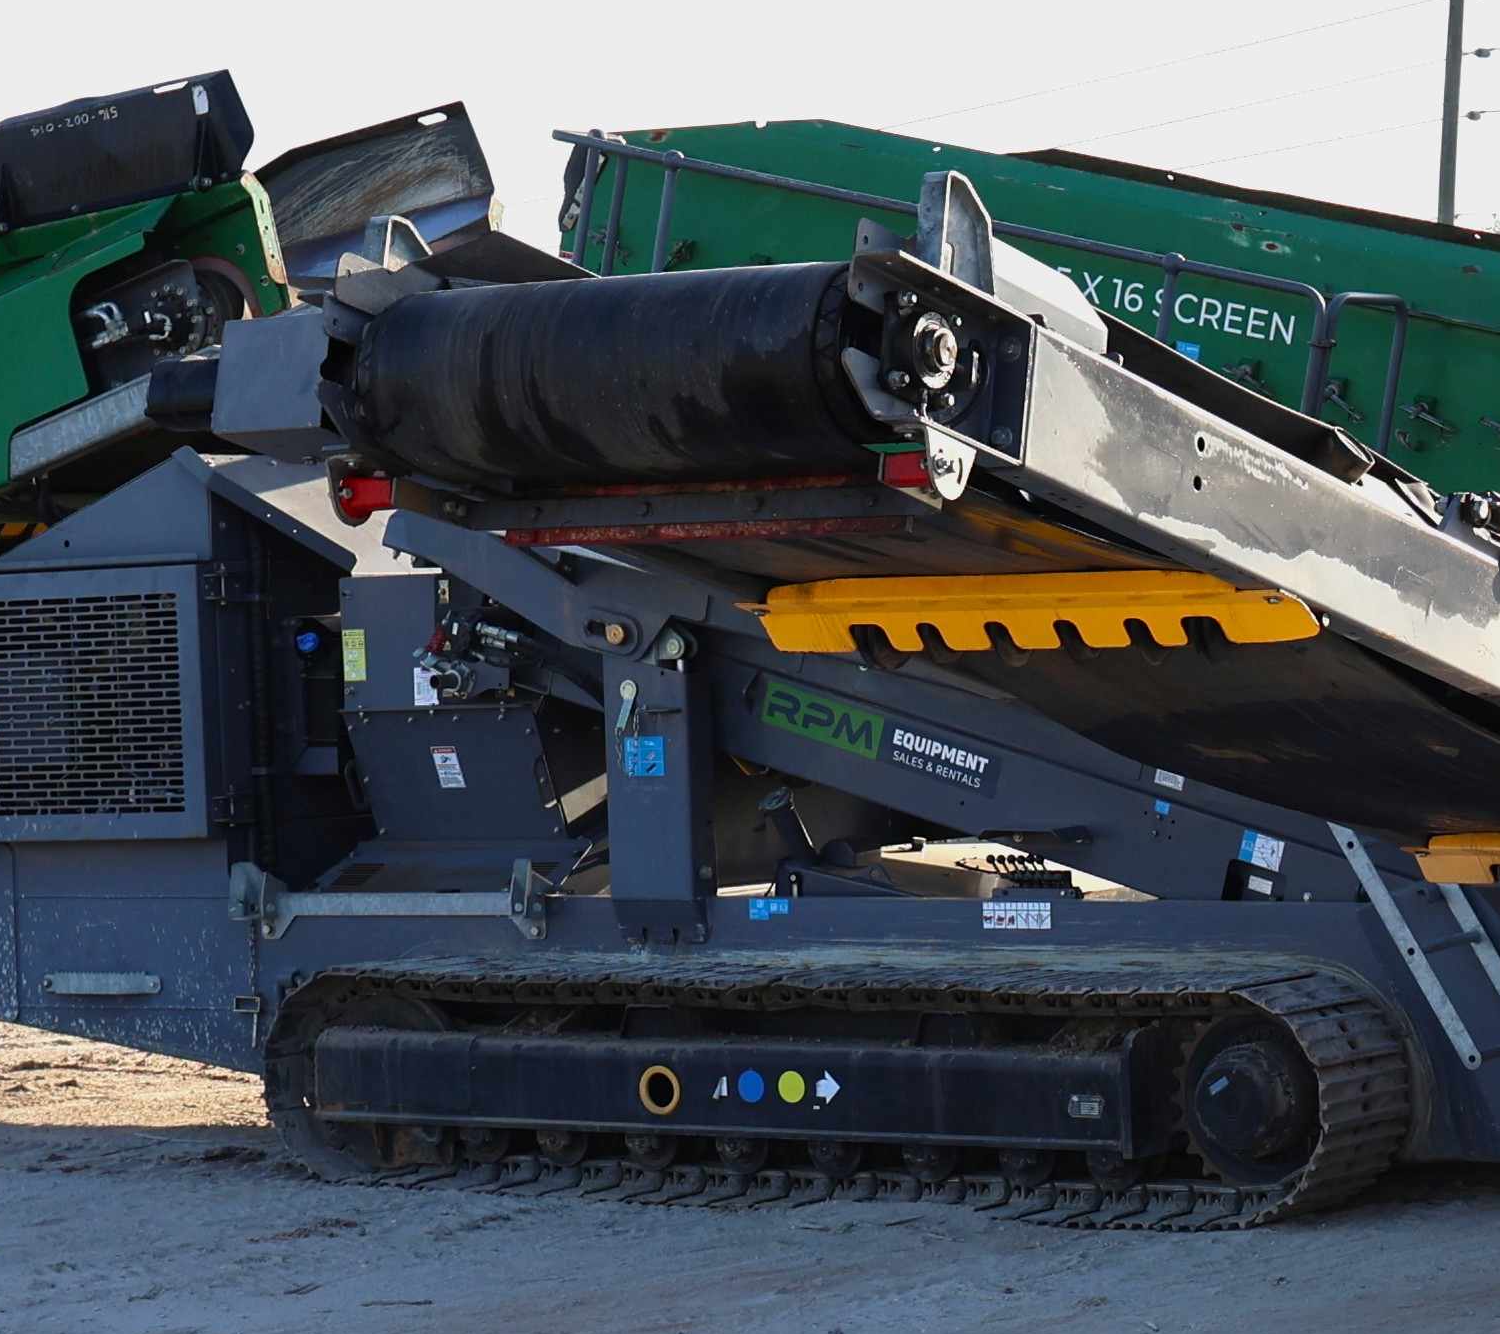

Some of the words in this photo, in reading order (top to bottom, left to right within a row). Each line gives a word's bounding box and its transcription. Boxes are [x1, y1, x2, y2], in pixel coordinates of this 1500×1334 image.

[1082, 271, 1104, 305] X
[1112, 278, 1145, 313] 16
[767, 690, 874, 750] RPM
[892, 728, 989, 774] EQUIPMENT
[892, 750, 924, 769] SALES
[925, 761, 934, 773] &
[935, 764, 981, 789] RENTALS
